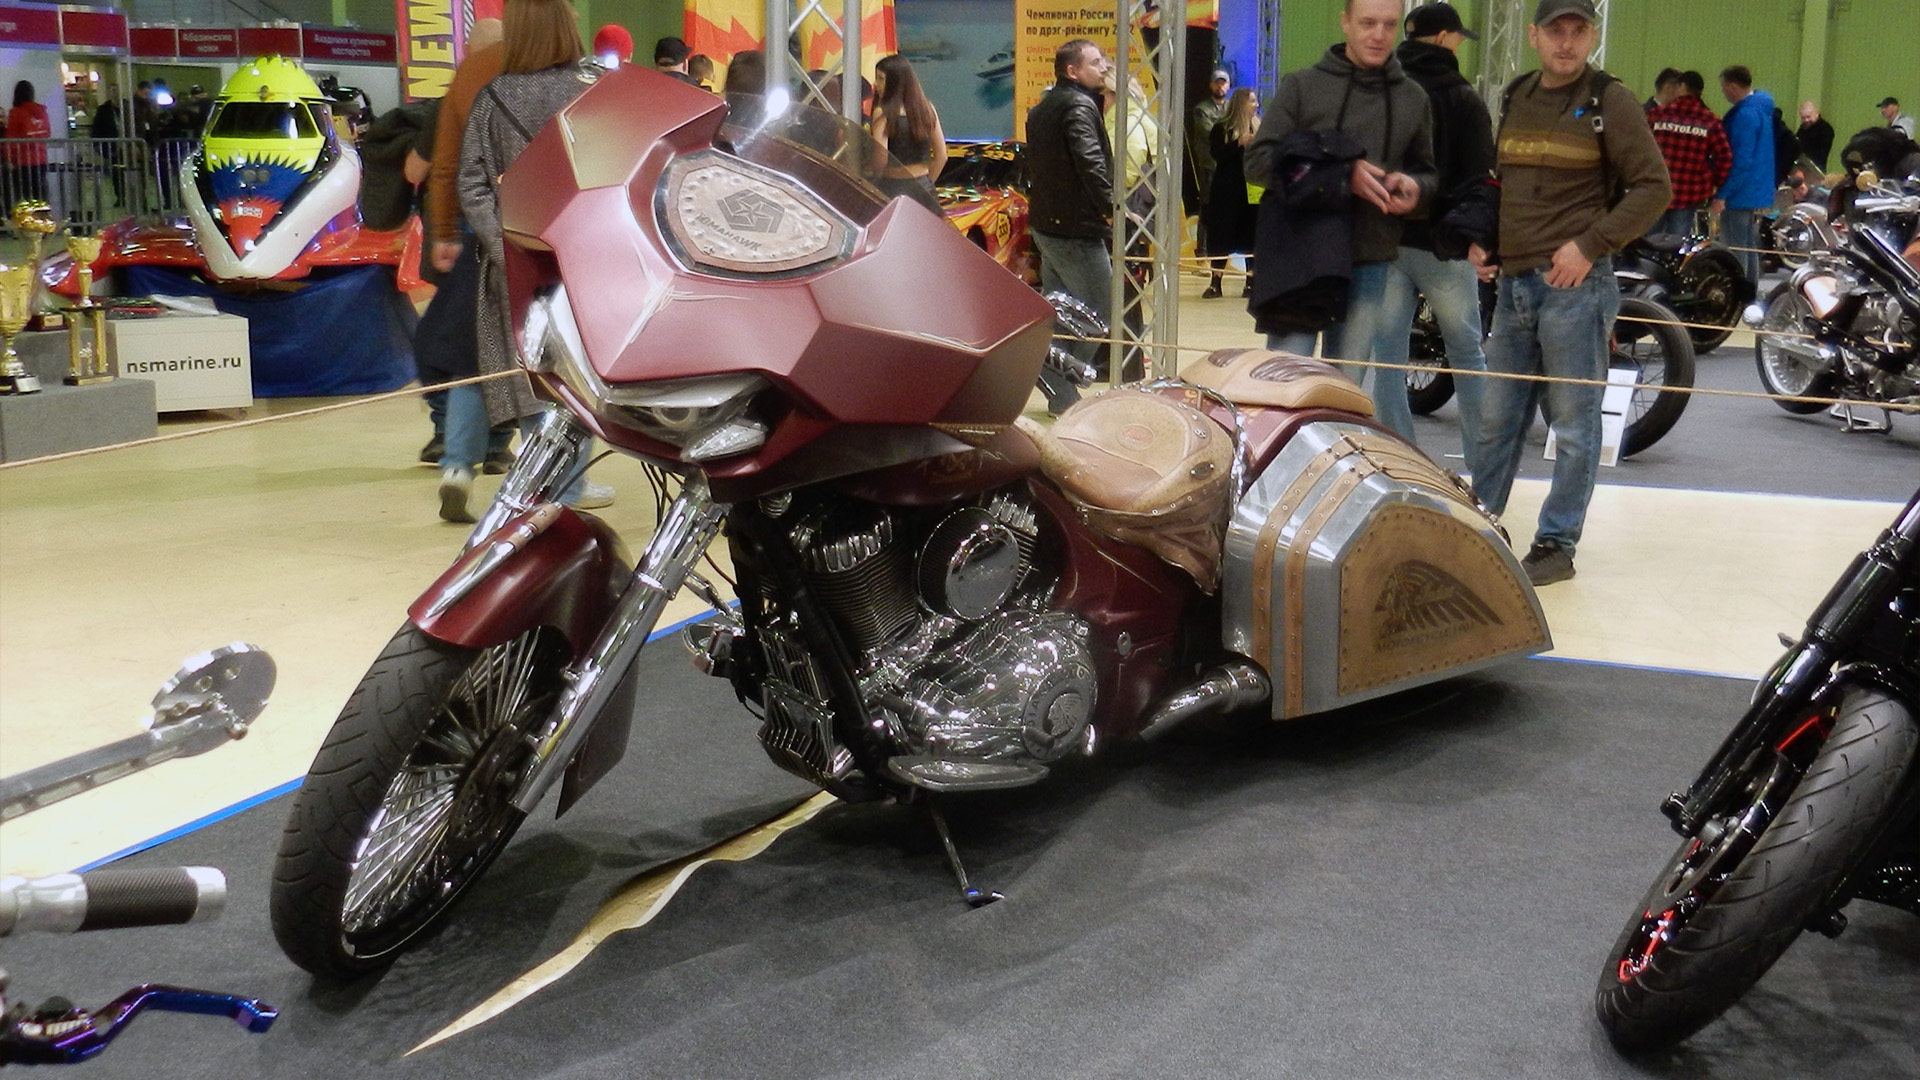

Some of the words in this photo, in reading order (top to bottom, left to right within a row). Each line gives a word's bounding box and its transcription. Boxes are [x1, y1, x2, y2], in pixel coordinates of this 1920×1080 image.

[1026, 9, 1078, 20] Чемпионат
[1080, 9, 1115, 20] России
[1026, 27, 1037, 35] по
[1039, 24, 1110, 37] дрэг-рейсингу
[1112, 24, 1134, 35] 22
[407, 0, 456, 98] NEW
[694, 212, 763, 252] TOMAHAWK
[126, 355, 242, 374] nsmarine.ru
